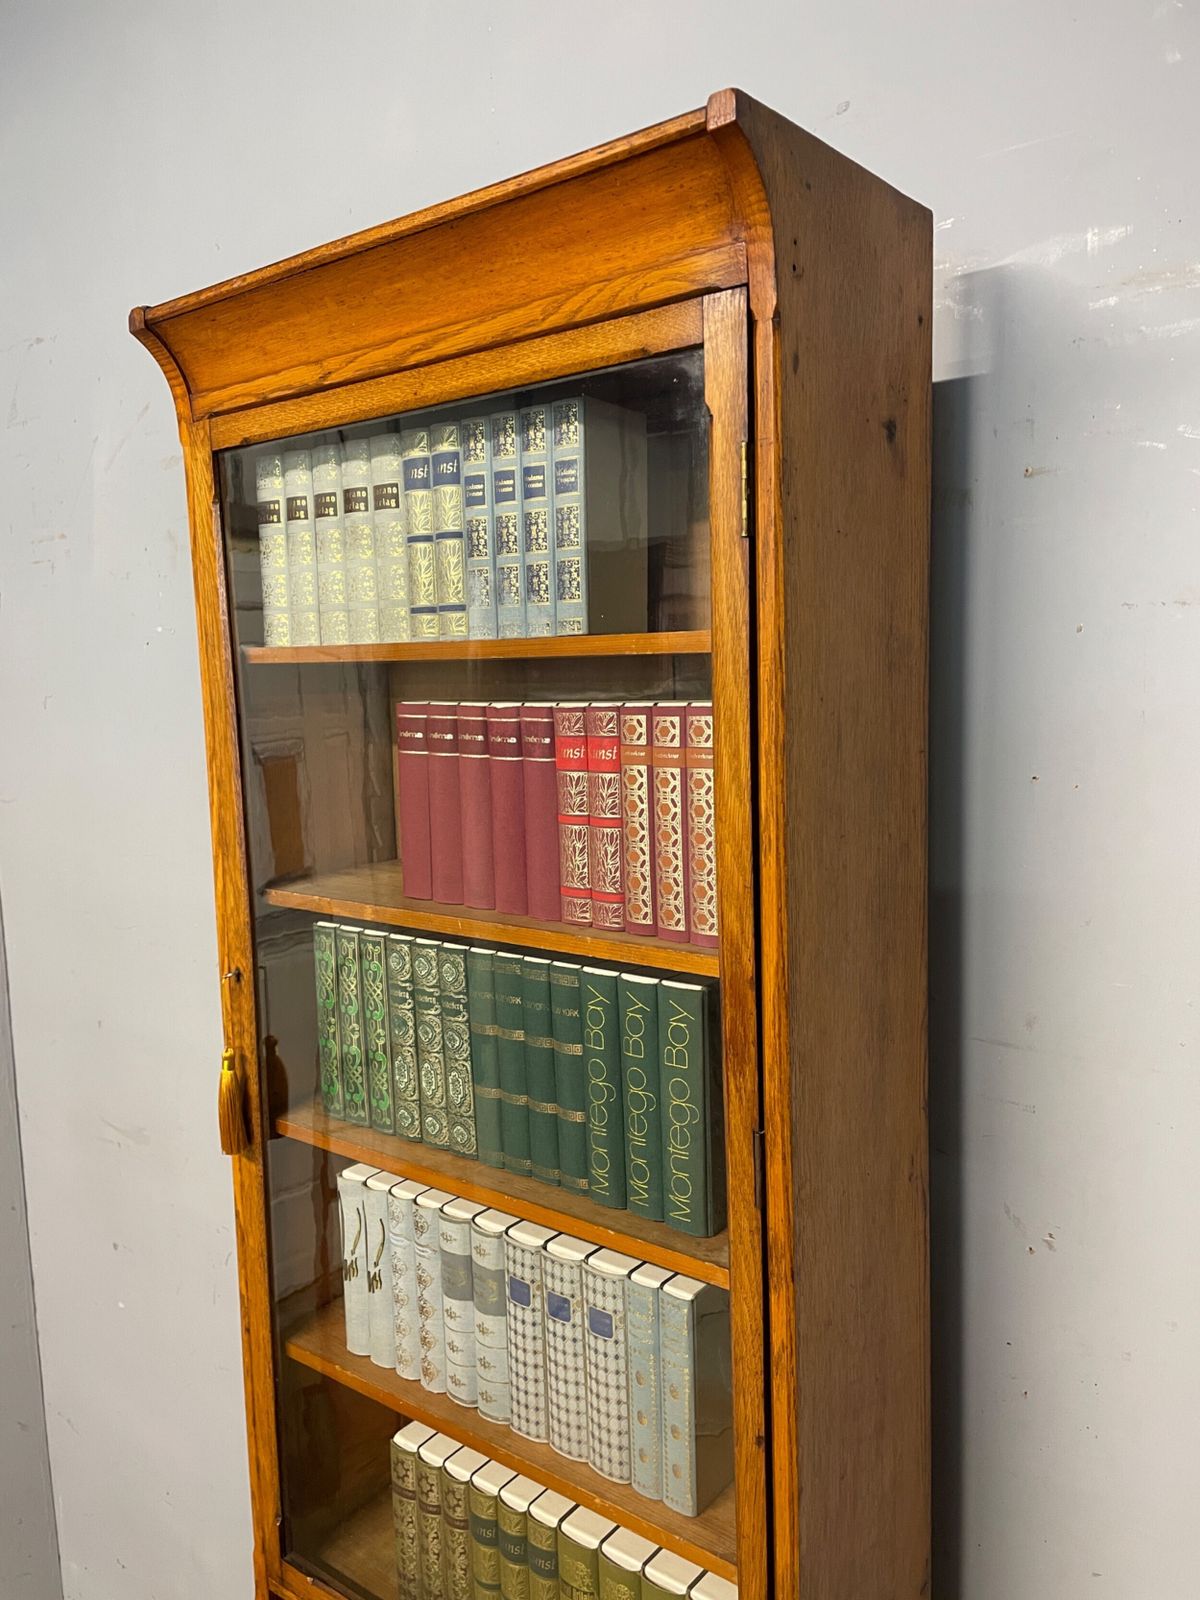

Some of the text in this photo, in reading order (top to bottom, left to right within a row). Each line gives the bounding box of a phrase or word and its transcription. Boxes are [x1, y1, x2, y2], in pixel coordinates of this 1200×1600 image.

[410, 464, 429, 479] nst
[584, 984, 616, 1195] Montego Bay
[623, 991, 656, 1206] Montego Bay
[664, 1000, 699, 1222] Montego Bay
